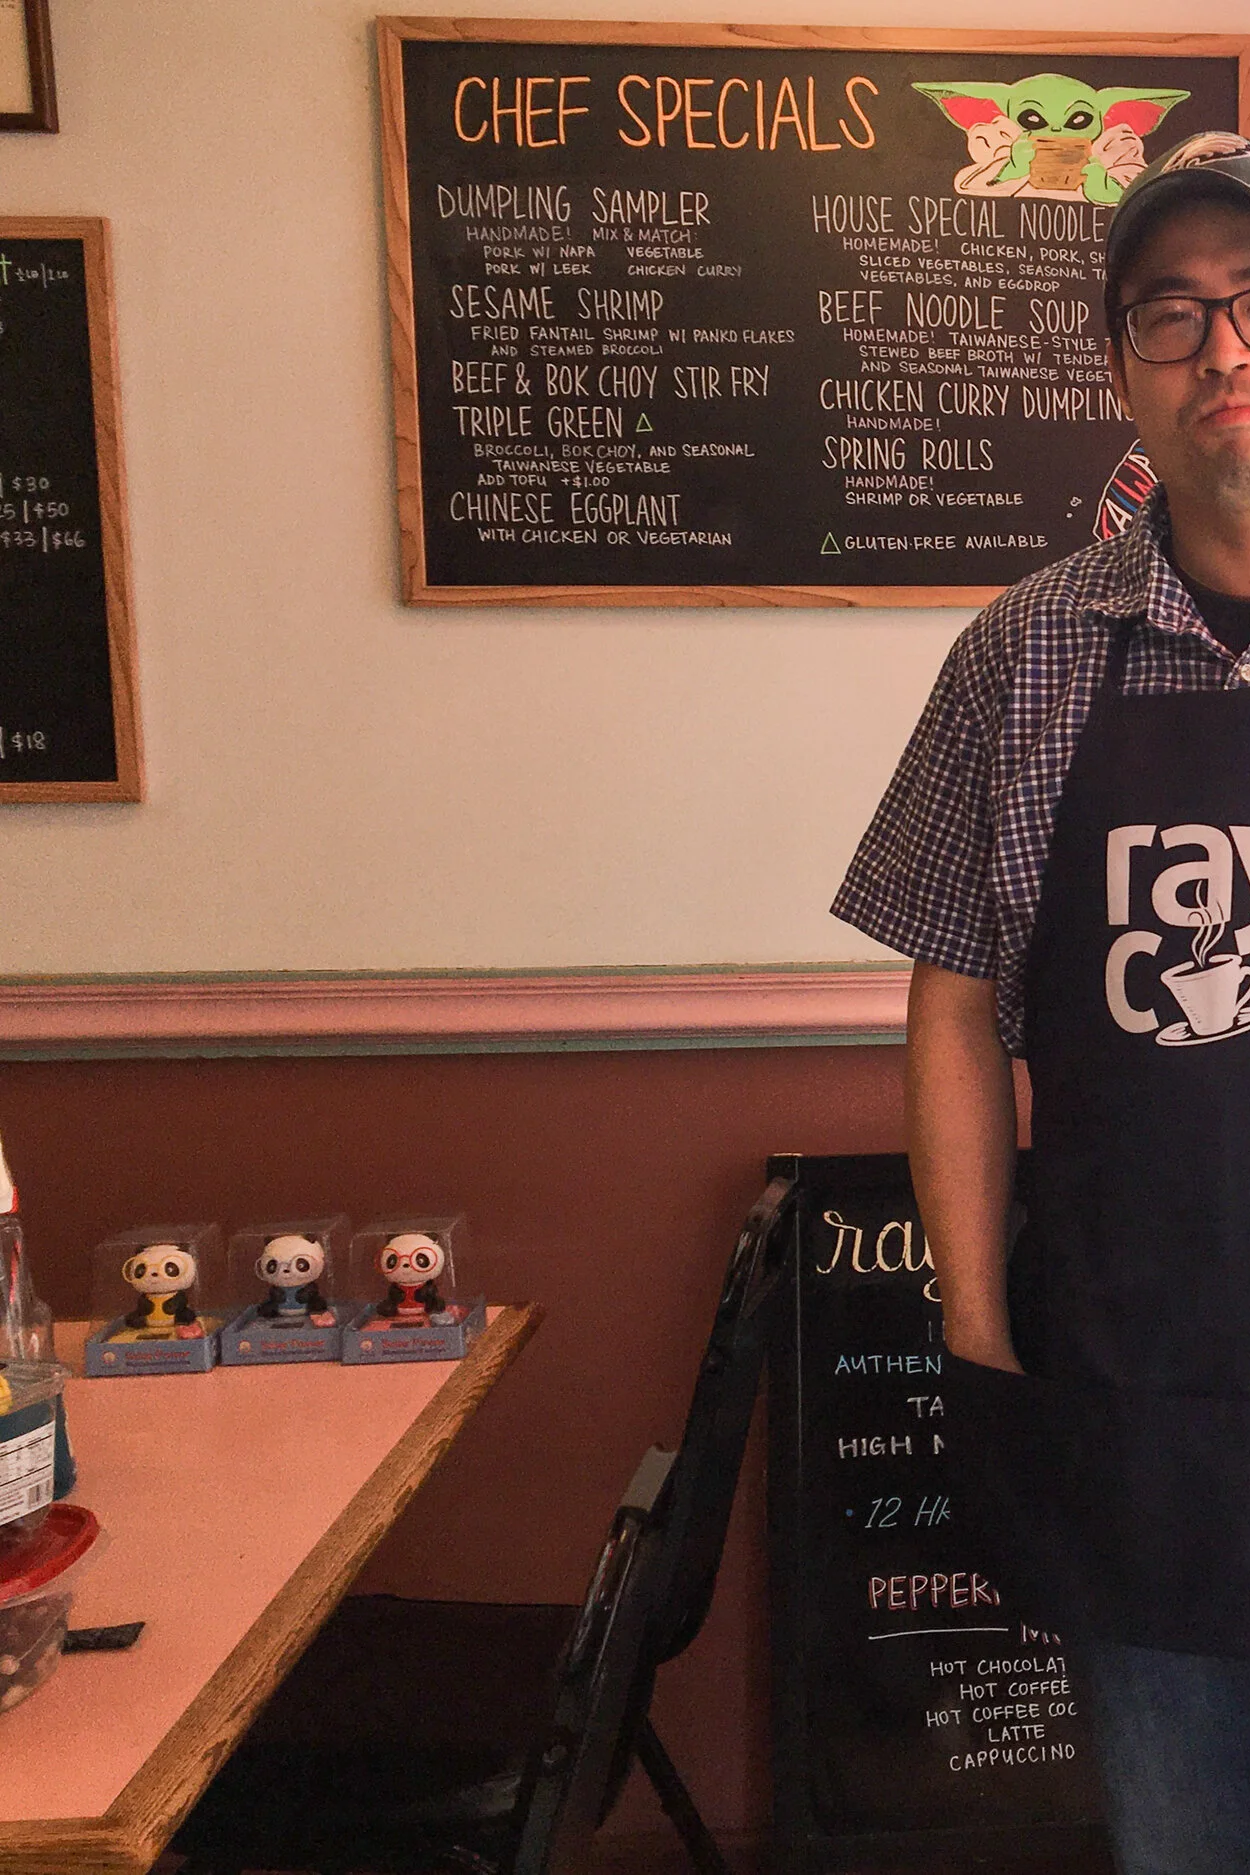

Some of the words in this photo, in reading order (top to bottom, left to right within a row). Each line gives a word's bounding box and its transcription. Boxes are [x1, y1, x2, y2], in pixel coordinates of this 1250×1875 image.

[454, 76, 591, 148] CHEF
[618, 74, 879, 152] SPECIALS
[437, 184, 571, 223] DUMPLING
[592, 186, 711, 226] SAMPLER
[812, 194, 894, 234] HOUSE
[908, 195, 1005, 239] SPECIAL
[1020, 203, 1106, 243] NOODLE
[466, 224, 571, 242] HANDMADE!
[592, 226, 619, 241] MIX
[623, 226, 634, 242] &
[638, 228, 698, 246] MATCH:
[483, 245, 525, 259] PORK
[560, 244, 596, 258] NAPA
[626, 246, 704, 260] VEGETABLE
[842, 236, 939, 254] HOMEMADE!
[960, 242, 1033, 262] CHICKEN,
[1039, 247, 1085, 265] PORK,
[485, 262, 521, 275] PORK
[553, 263, 592, 275] LEEK
[627, 264, 686, 277] CHICKEN
[697, 264, 742, 277] CURRY
[859, 254, 911, 268] SLICED
[917, 257, 1010, 275] VEGETABLES,
[1018, 263, 1087, 280] SEASONAL
[859, 269, 957, 288] VEGETABLES,
[964, 276, 992, 289] AND
[998, 278, 1061, 293] EGGDROP
[449, 284, 555, 320] SESAME
[578, 287, 664, 322] SHRIMP
[819, 290, 884, 325] BEEF
[906, 292, 1006, 331] NOODLE
[1029, 298, 1089, 335] SOUP
[471, 325, 519, 341] FRIED
[529, 325, 595, 341] FANTAIL
[602, 327, 659, 342] SHRIMP
[693, 328, 738, 343] PANKO
[742, 329, 795, 344] FLAKES
[843, 327, 935, 344] HOMEMADE!
[948, 331, 1097, 352] TAIWANESE-STYLE
[491, 344, 518, 357] AND
[530, 344, 594, 357] STEAMED
[602, 343, 664, 356] BROCCOLI
[858, 344, 920, 359] STEWED
[928, 347, 961, 360] BEEF
[967, 349, 1014, 364] BROTH
[452, 359, 508, 394] BEEF
[515, 363, 532, 396] &
[546, 363, 590, 396] BOK
[598, 365, 658, 399] CHOY
[673, 366, 722, 400] STIR
[730, 364, 769, 397] FRY
[860, 360, 891, 373] AND
[898, 360, 973, 377] SEASONAL
[977, 365, 1060, 382] TAIWANESE
[820, 378, 924, 413] CHICKEN
[938, 381, 1010, 417] CURRY
[452, 405, 532, 437] TRIPLE
[547, 405, 622, 439] GREEN
[846, 414, 940, 432] HANDMADE!
[474, 443, 554, 460] BROCCOLI,
[562, 444, 594, 457] BOK
[596, 443, 642, 459] CHOY,
[649, 445, 677, 457] AND
[681, 443, 755, 457] SEASONAL
[821, 435, 906, 471] SPRING
[922, 438, 994, 471] ROLLS
[495, 460, 581, 474] TAIWANESE
[584, 459, 671, 474] VEGETABLE
[477, 473, 505, 486] ADD
[508, 474, 547, 487] TOFU
[560, 475, 610, 489] +$1.00
[845, 474, 934, 490] HANDMADE!
[450, 491, 554, 524] CHINESE
[571, 492, 681, 527] EGGPLANT
[845, 491, 903, 506] SHRIMP
[908, 493, 932, 506] OR
[935, 492, 1024, 507] VEGETABLE
[477, 527, 516, 542] WITH
[521, 528, 597, 544] CHICKEN
[606, 530, 631, 545] OR
[636, 530, 732, 546] VEGETARIAN
[844, 535, 956, 551] GLUTEN-FREE
[965, 534, 1049, 549] AVAILABLE
[11, 731, 46, 752] $18
[838, 1435, 913, 1459] HIGH
[864, 1496, 902, 1529] 12
[869, 1572, 1000, 1610] PEPPER
[930, 1660, 967, 1677] HOT
[959, 1682, 998, 1701] HOT
[1008, 1679, 1071, 1697] COFFEE
[926, 1709, 961, 1727] HOT
[972, 1703, 1040, 1723] COFFEE
[988, 1724, 1045, 1743] LATTE
[949, 1743, 1075, 1772] CAPPUCCINO
